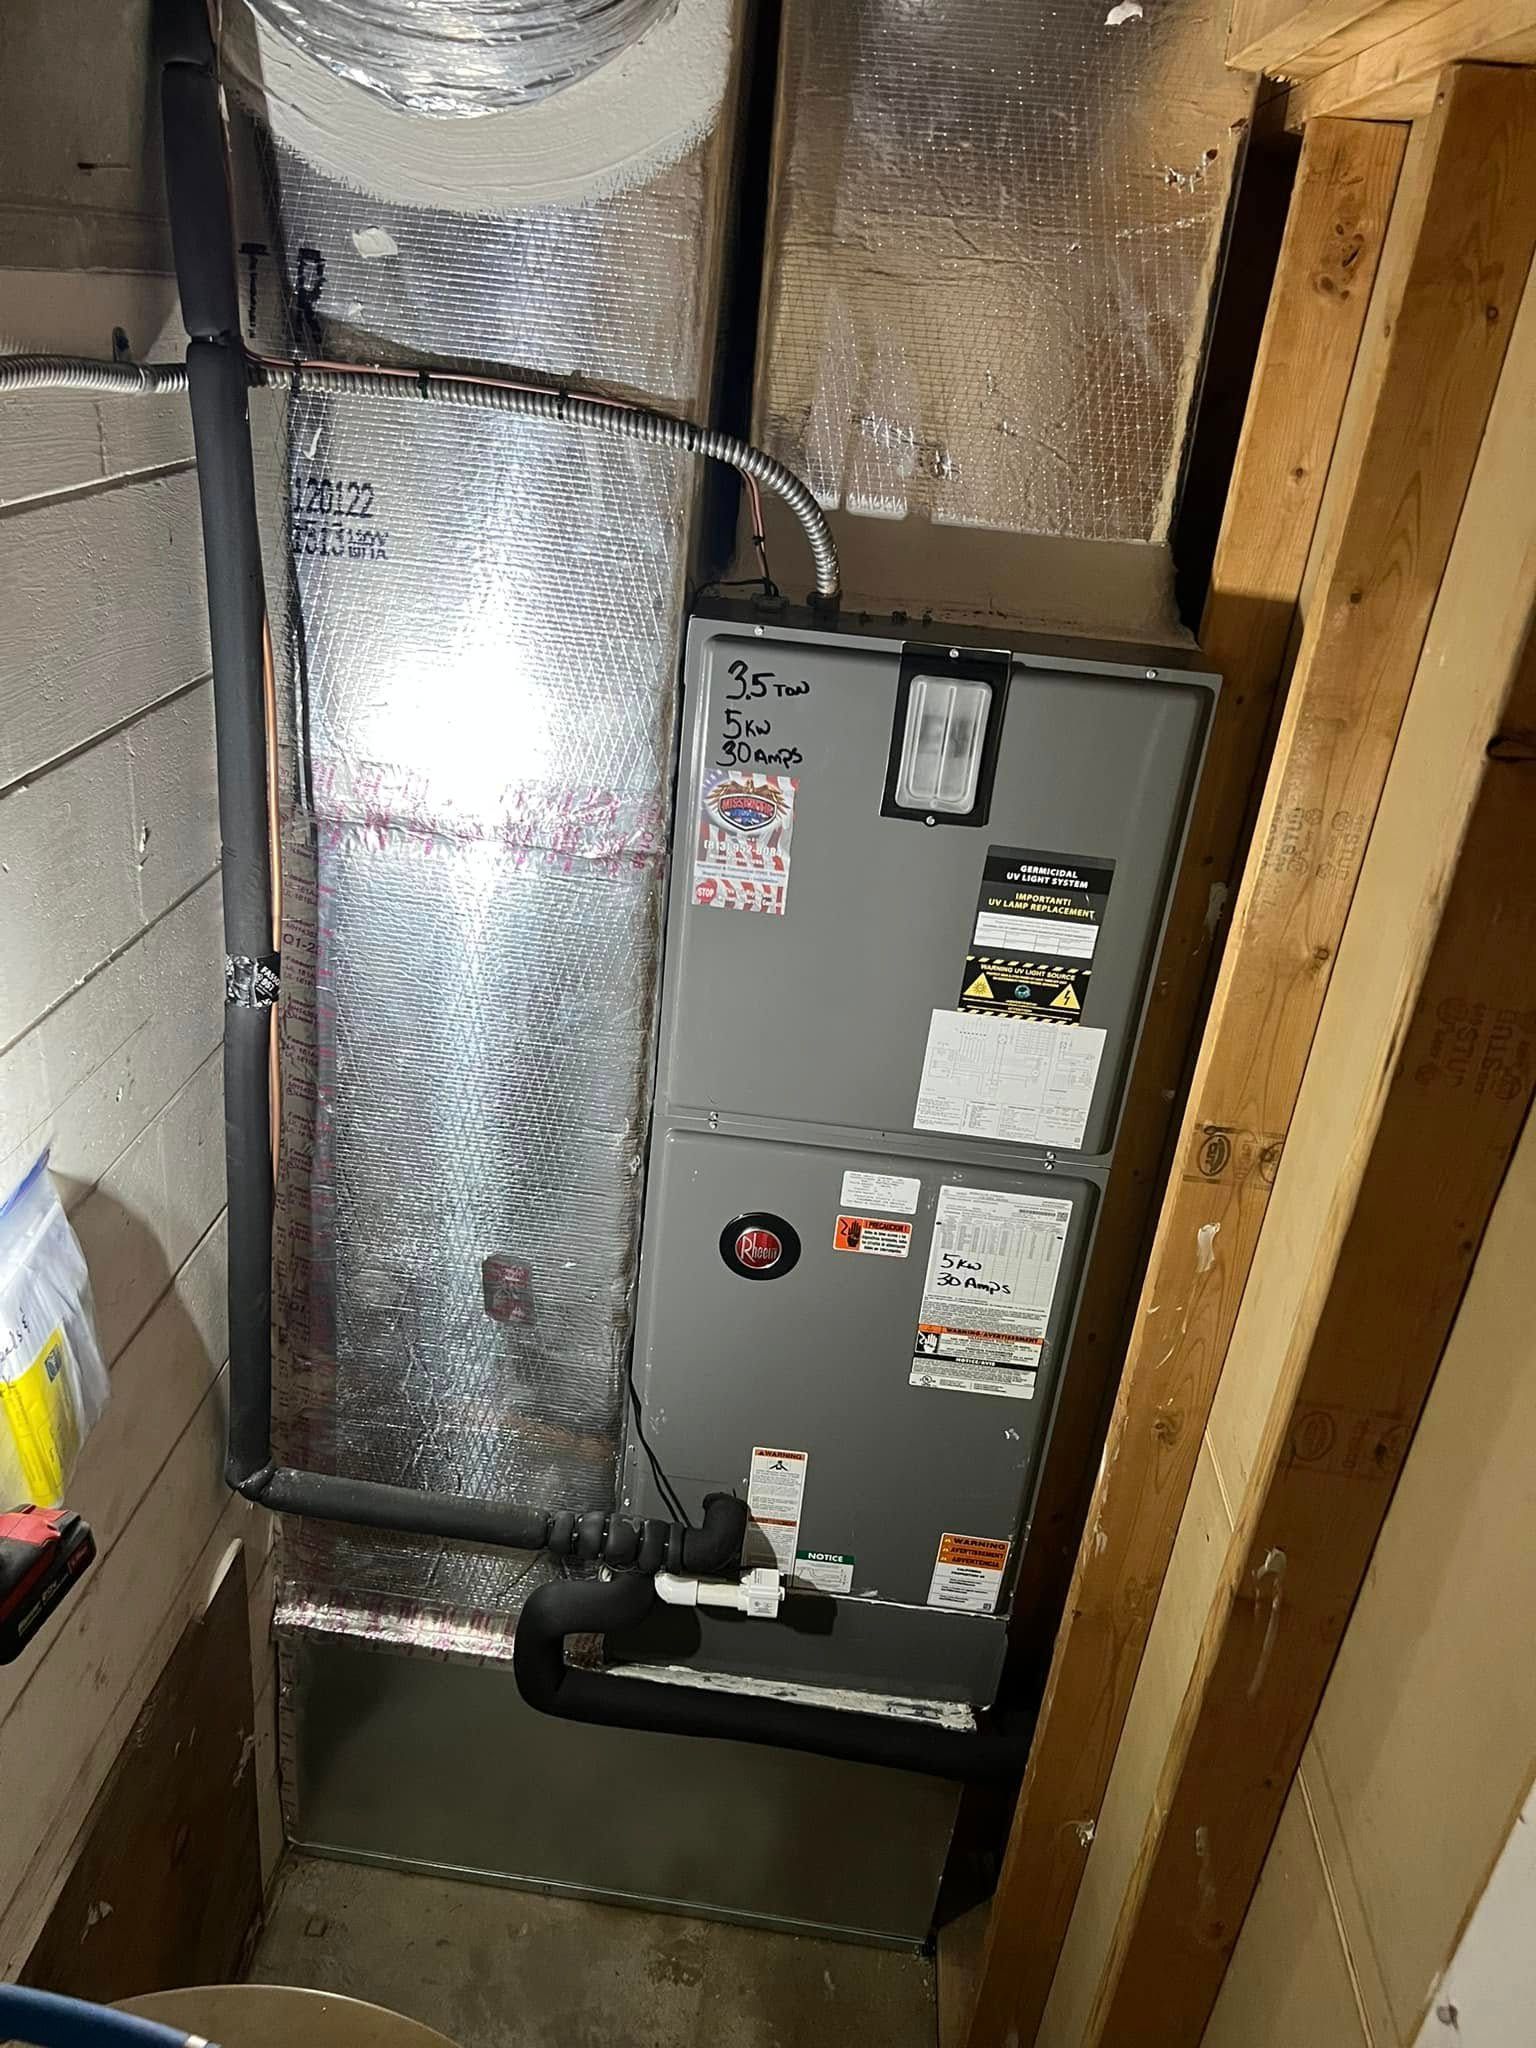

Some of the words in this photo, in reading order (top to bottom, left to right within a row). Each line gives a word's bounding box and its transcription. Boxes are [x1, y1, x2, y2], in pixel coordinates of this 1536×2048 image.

[726, 660, 775, 700] 3.5
[1020, 865, 1078, 879] GERMICIDAL
[1006, 872, 1020, 881] UV
[1021, 873, 1051, 884] LIGHT
[1051, 877, 1088, 889] SYSTEM
[697, 887, 715, 898] STOP
[988, 898, 1002, 906] UV
[1003, 900, 1028, 910] LAMP
[1030, 904, 1096, 919] REPLACEMENT
[981, 963, 1012, 974] WARNING
[1025, 969, 1046, 978] LIGHT
[1047, 971, 1076, 981] SOURCE
[741, 1232, 778, 1263] Rheem
[765, 1450, 803, 1461] WARNING
[954, 1537, 1006, 1551] WARNING
[807, 1551, 844, 1563] NOTICE
